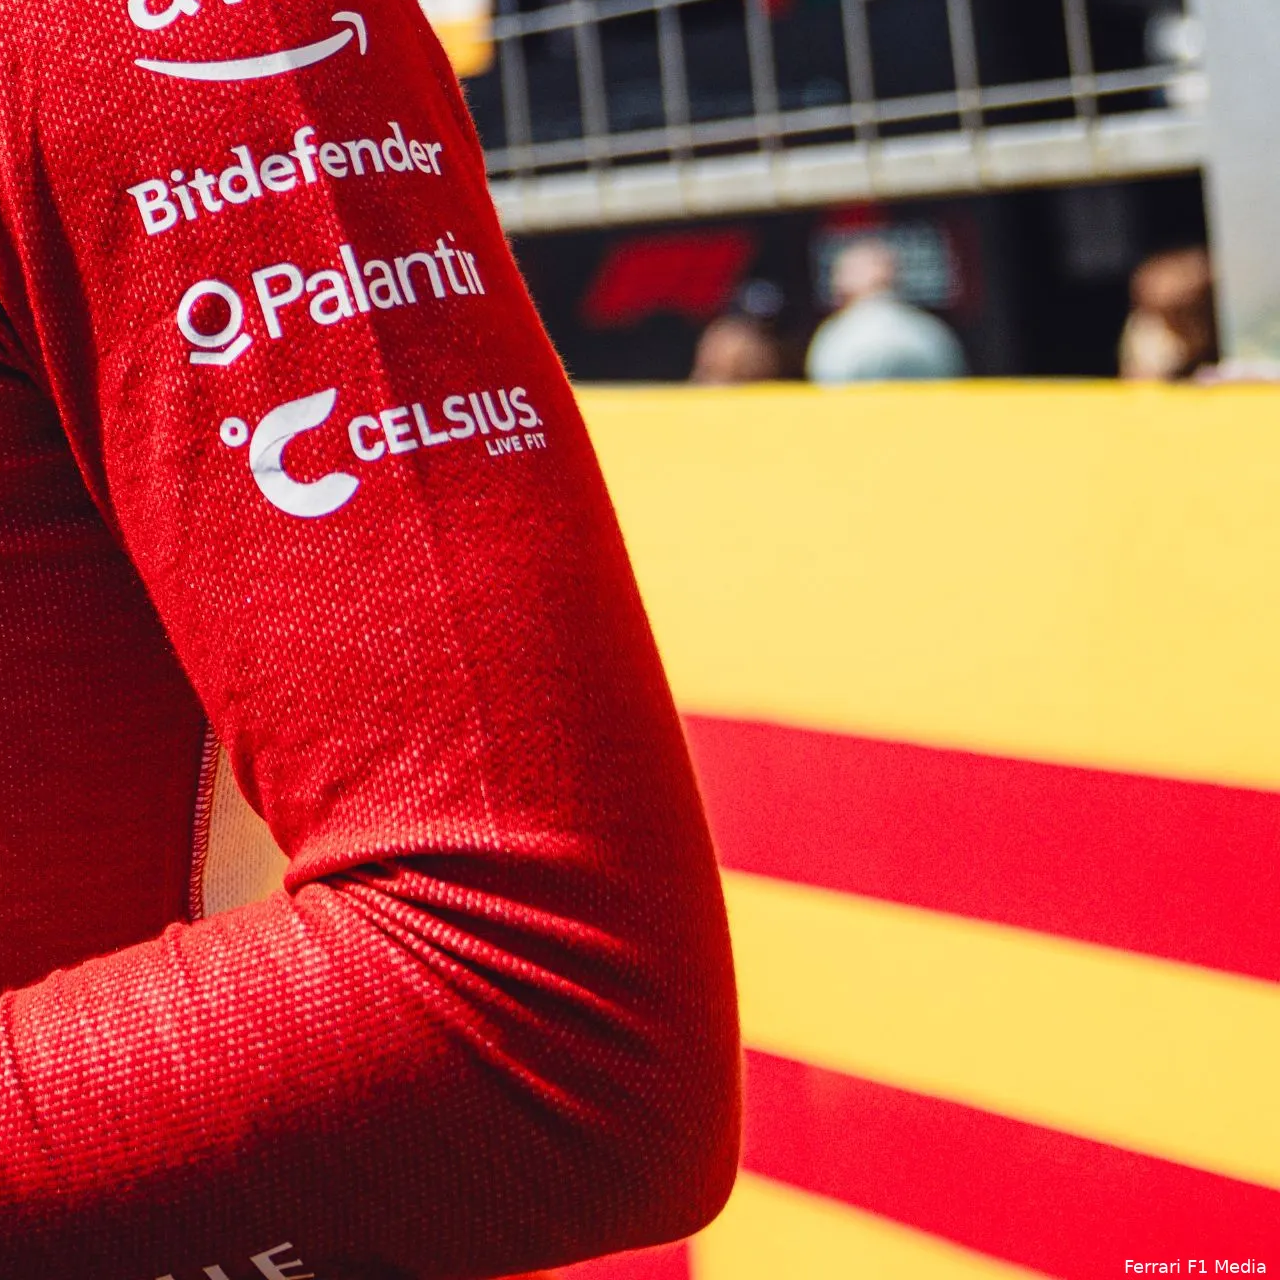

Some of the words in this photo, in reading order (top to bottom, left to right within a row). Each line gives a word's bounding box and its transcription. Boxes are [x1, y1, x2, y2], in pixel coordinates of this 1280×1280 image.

[126, 121, 442, 236] Bitdefender
[251, 231, 486, 339] Palantir
[484, 435, 524, 457] LIVE
[523, 432, 547, 450] FIT
